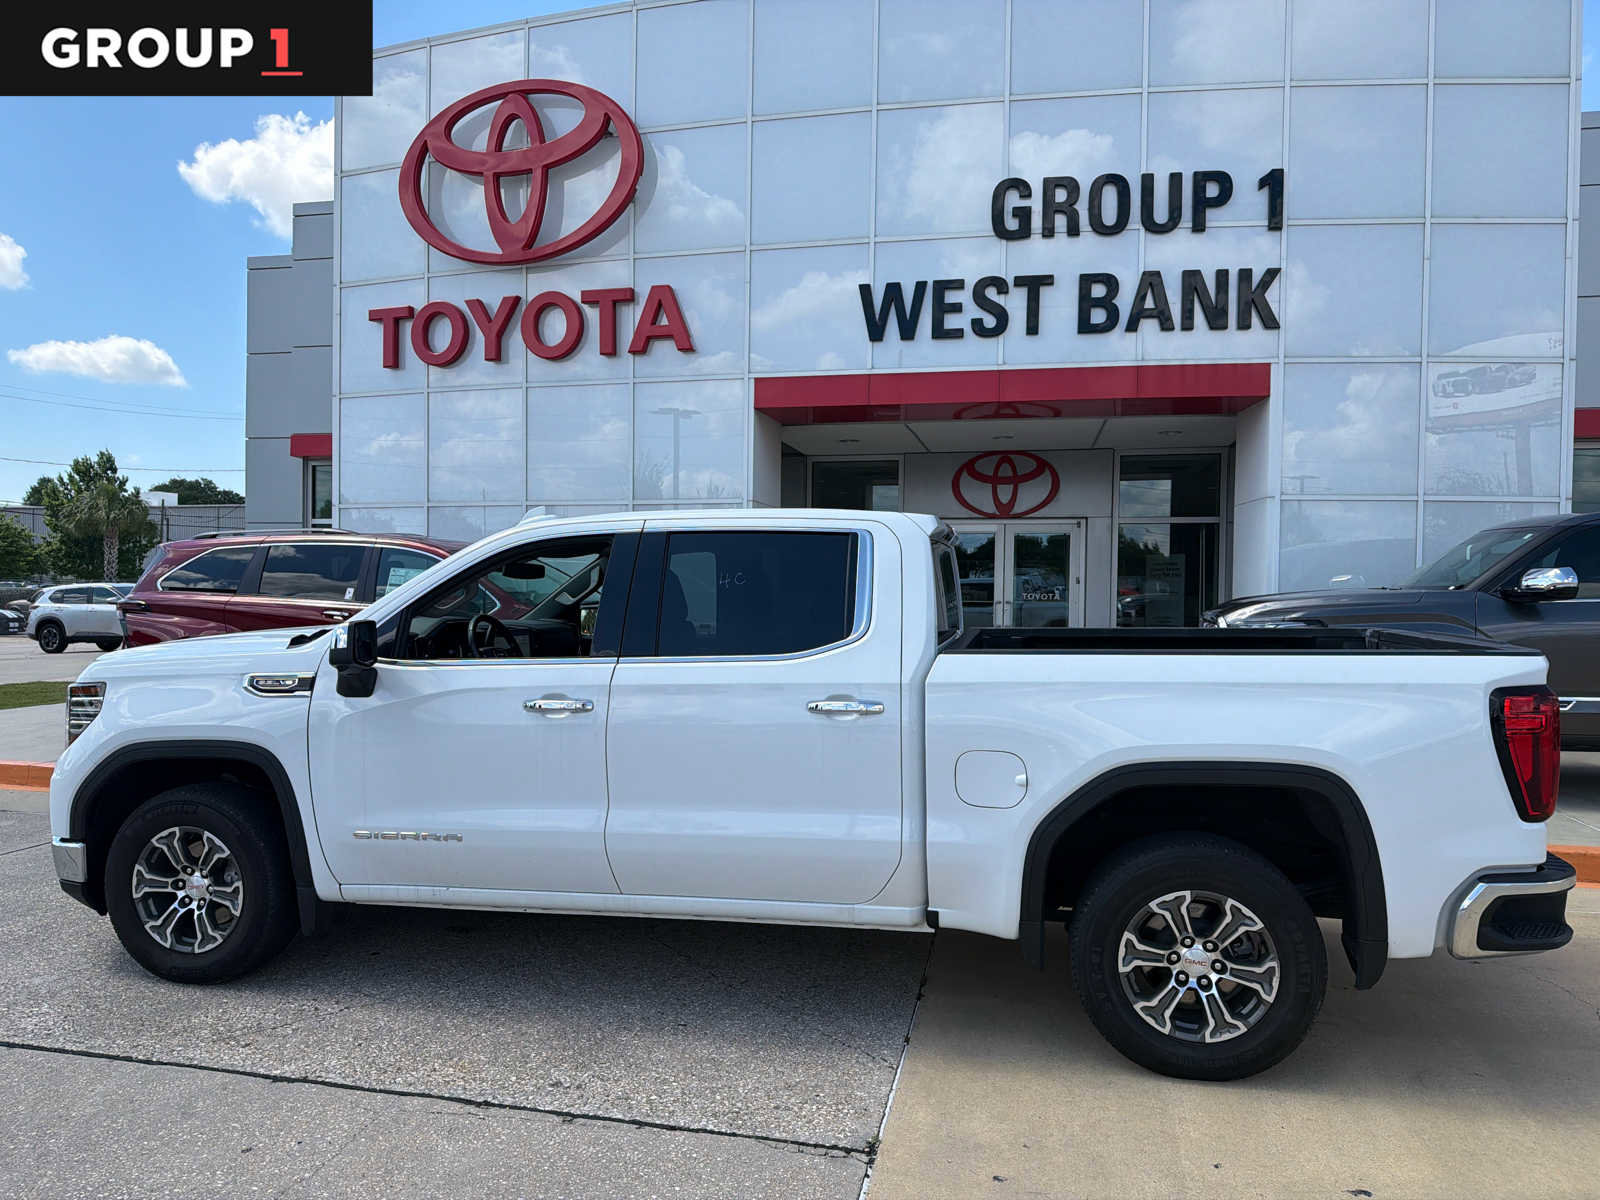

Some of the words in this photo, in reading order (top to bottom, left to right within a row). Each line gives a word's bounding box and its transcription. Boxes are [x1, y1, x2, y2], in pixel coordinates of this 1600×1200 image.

[991, 170, 1234, 240] GROUP
[1257, 168, 1285, 231] 1
[858, 274, 1055, 342] WEST
[1077, 267, 1282, 335] BANK
[368, 284, 696, 369] TOYOTA
[1022, 592, 1060, 600] TOYOTA
[352, 830, 463, 842] SIERRA
[1184, 958, 1208, 967] GMC
